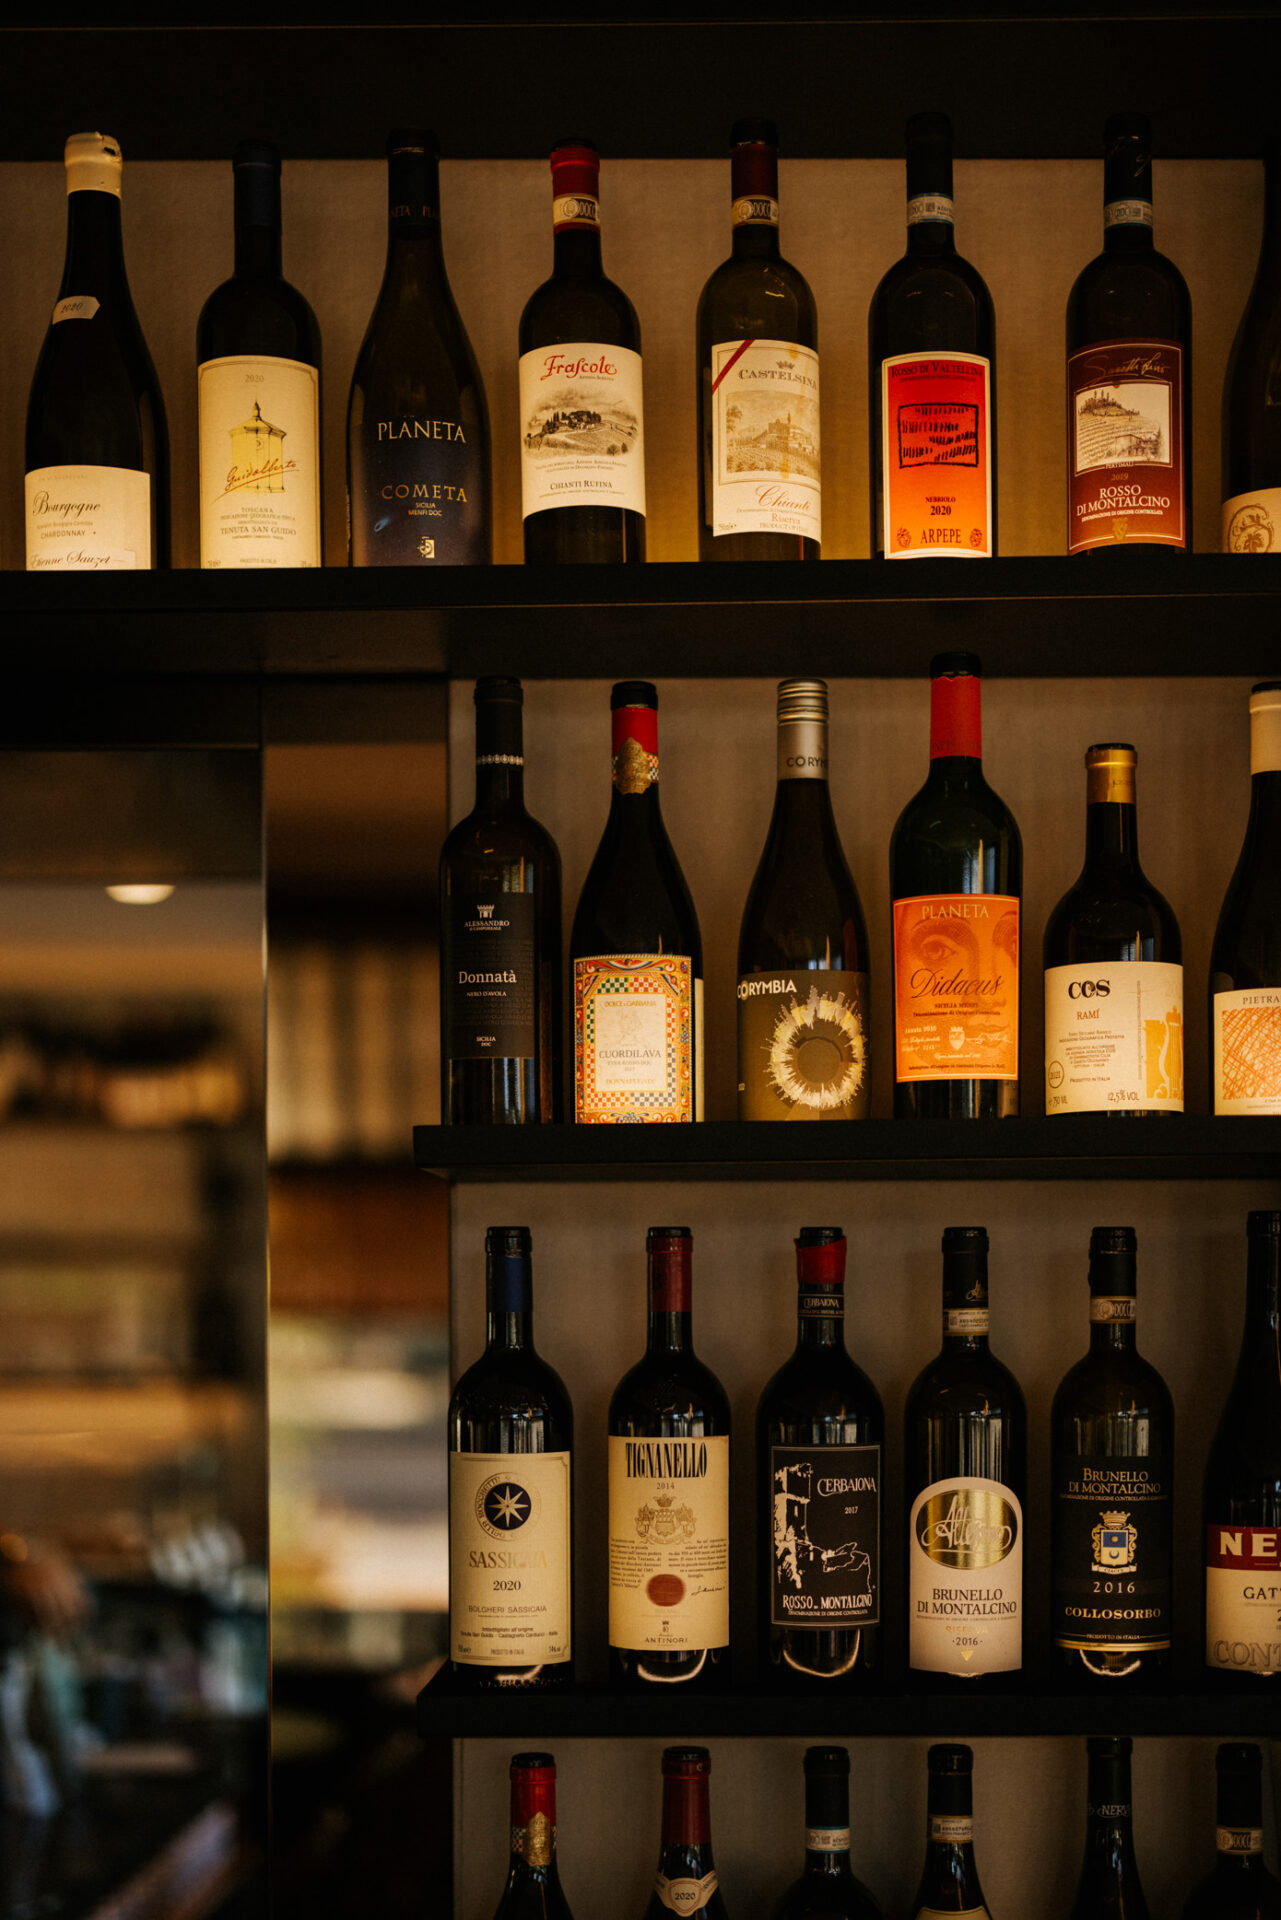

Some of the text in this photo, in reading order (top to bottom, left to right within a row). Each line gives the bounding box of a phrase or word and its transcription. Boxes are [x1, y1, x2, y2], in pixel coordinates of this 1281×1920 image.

[891, 365, 918, 378] ROSSO
[244, 374, 265, 384] 2020
[378, 420, 467, 443] PLANETA
[550, 479, 613, 490] CHIANTI RUFINA
[1099, 484, 1142, 499] ROSSO
[381, 484, 468, 503] COMETA
[32, 490, 102, 518] Bourgogne
[930, 505, 952, 516] 2020
[1076, 495, 1171, 516] DI MONTALCINO
[428, 509, 443, 517] DOC
[40, 529, 86, 540] CHARDONNAY
[220, 525, 298, 536] TENUTA SAN GUIDO
[920, 528, 962, 544] ARPEPE
[922, 903, 990, 920] PLANETA
[464, 920, 510, 928] ALESSANDRO
[458, 969, 518, 984] Donnatà
[910, 968, 1004, 999] Didacus
[737, 978, 798, 1000] CORYMBIA
[625, 1441, 708, 1479] TIGNANELLO
[1083, 1467, 1149, 1483] BRUNELLO
[656, 1481, 676, 1490] 2014
[816, 1476, 877, 1497] CERBAIONA
[1069, 1481, 1161, 1495] DI MONTALCINO
[844, 1506, 859, 1515] 2017
[492, 1580, 522, 1591] 2020
[1093, 1581, 1136, 1594] 2016
[1243, 1585, 1281, 1600] GAT
[783, 1593, 873, 1609] ROSSO MONTALCINO
[932, 1587, 1003, 1601] BRUNELLO
[468, 1605, 548, 1614] BOLGHERI SASSICAIA
[917, 1600, 1017, 1615] DI MONTALCINO
[1064, 1606, 1161, 1620] COLLOSORBO
[674, 1891, 696, 1901] 2020
